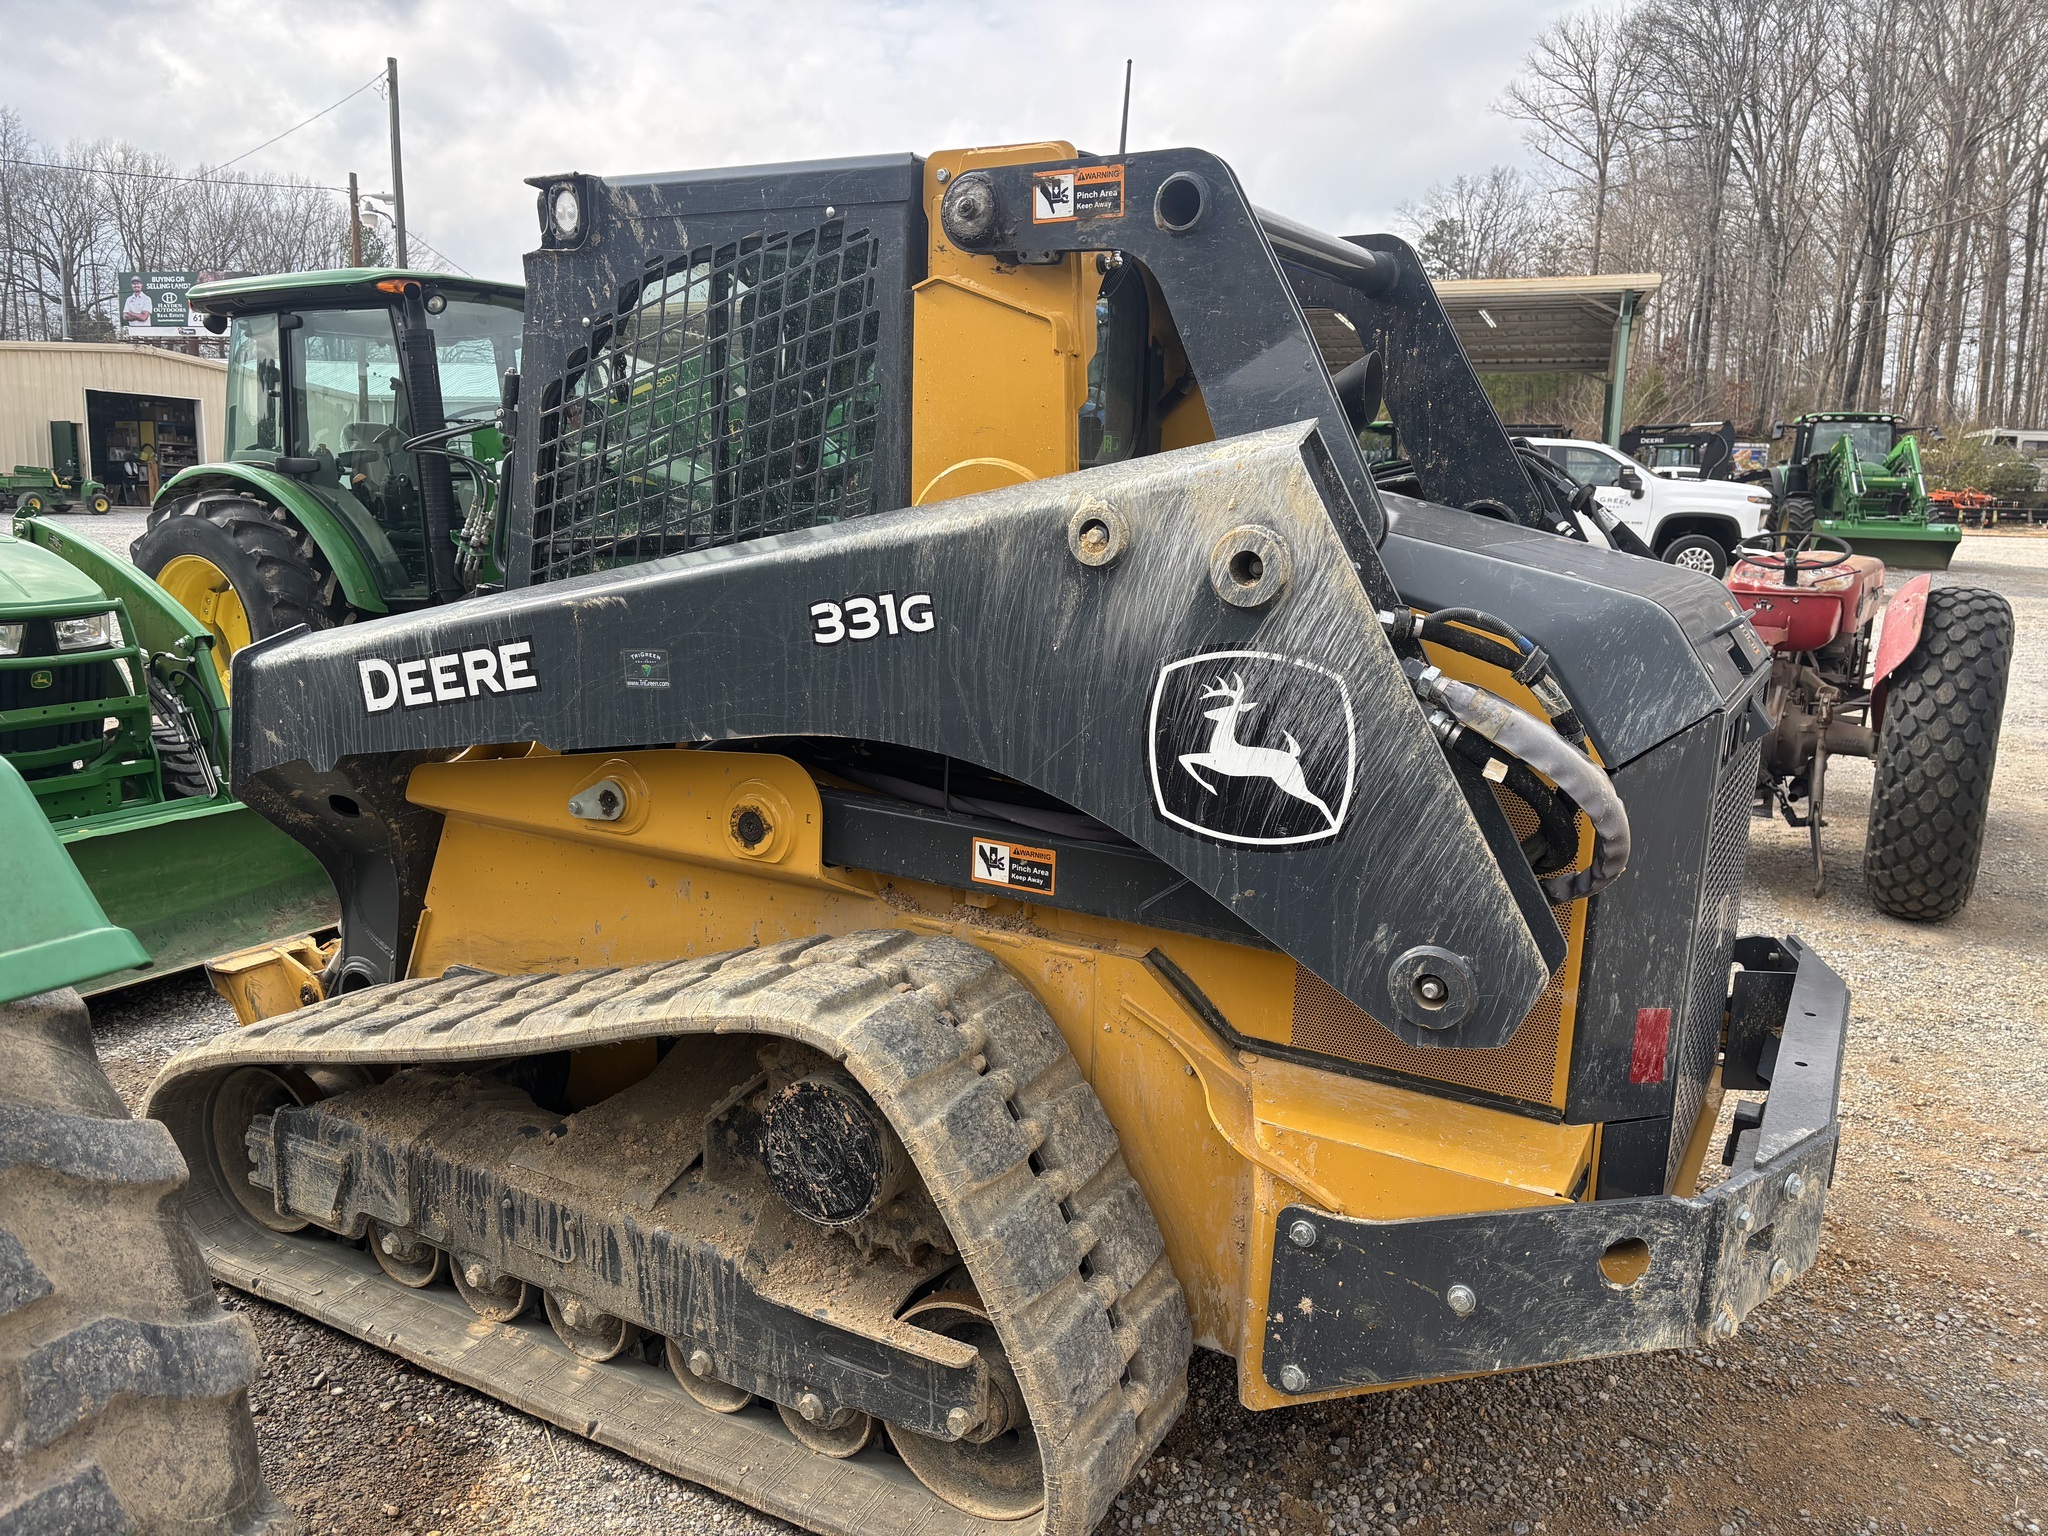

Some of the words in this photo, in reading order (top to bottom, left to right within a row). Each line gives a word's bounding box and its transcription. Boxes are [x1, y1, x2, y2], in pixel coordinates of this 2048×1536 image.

[1084, 170, 1120, 180] WARNING
[1076, 191, 1098, 200] Pinch
[1100, 190, 1118, 198] Area
[1598, 496, 1632, 507] GREEN
[810, 594, 934, 644] 331G
[358, 641, 537, 713] DEERE
[1019, 849, 1051, 860] WARNING
[1012, 864, 1032, 873] Pinch
[1032, 868, 1049, 876] Area
[1011, 873, 1027, 881] Keep
[1027, 877, 1044, 885] Away
